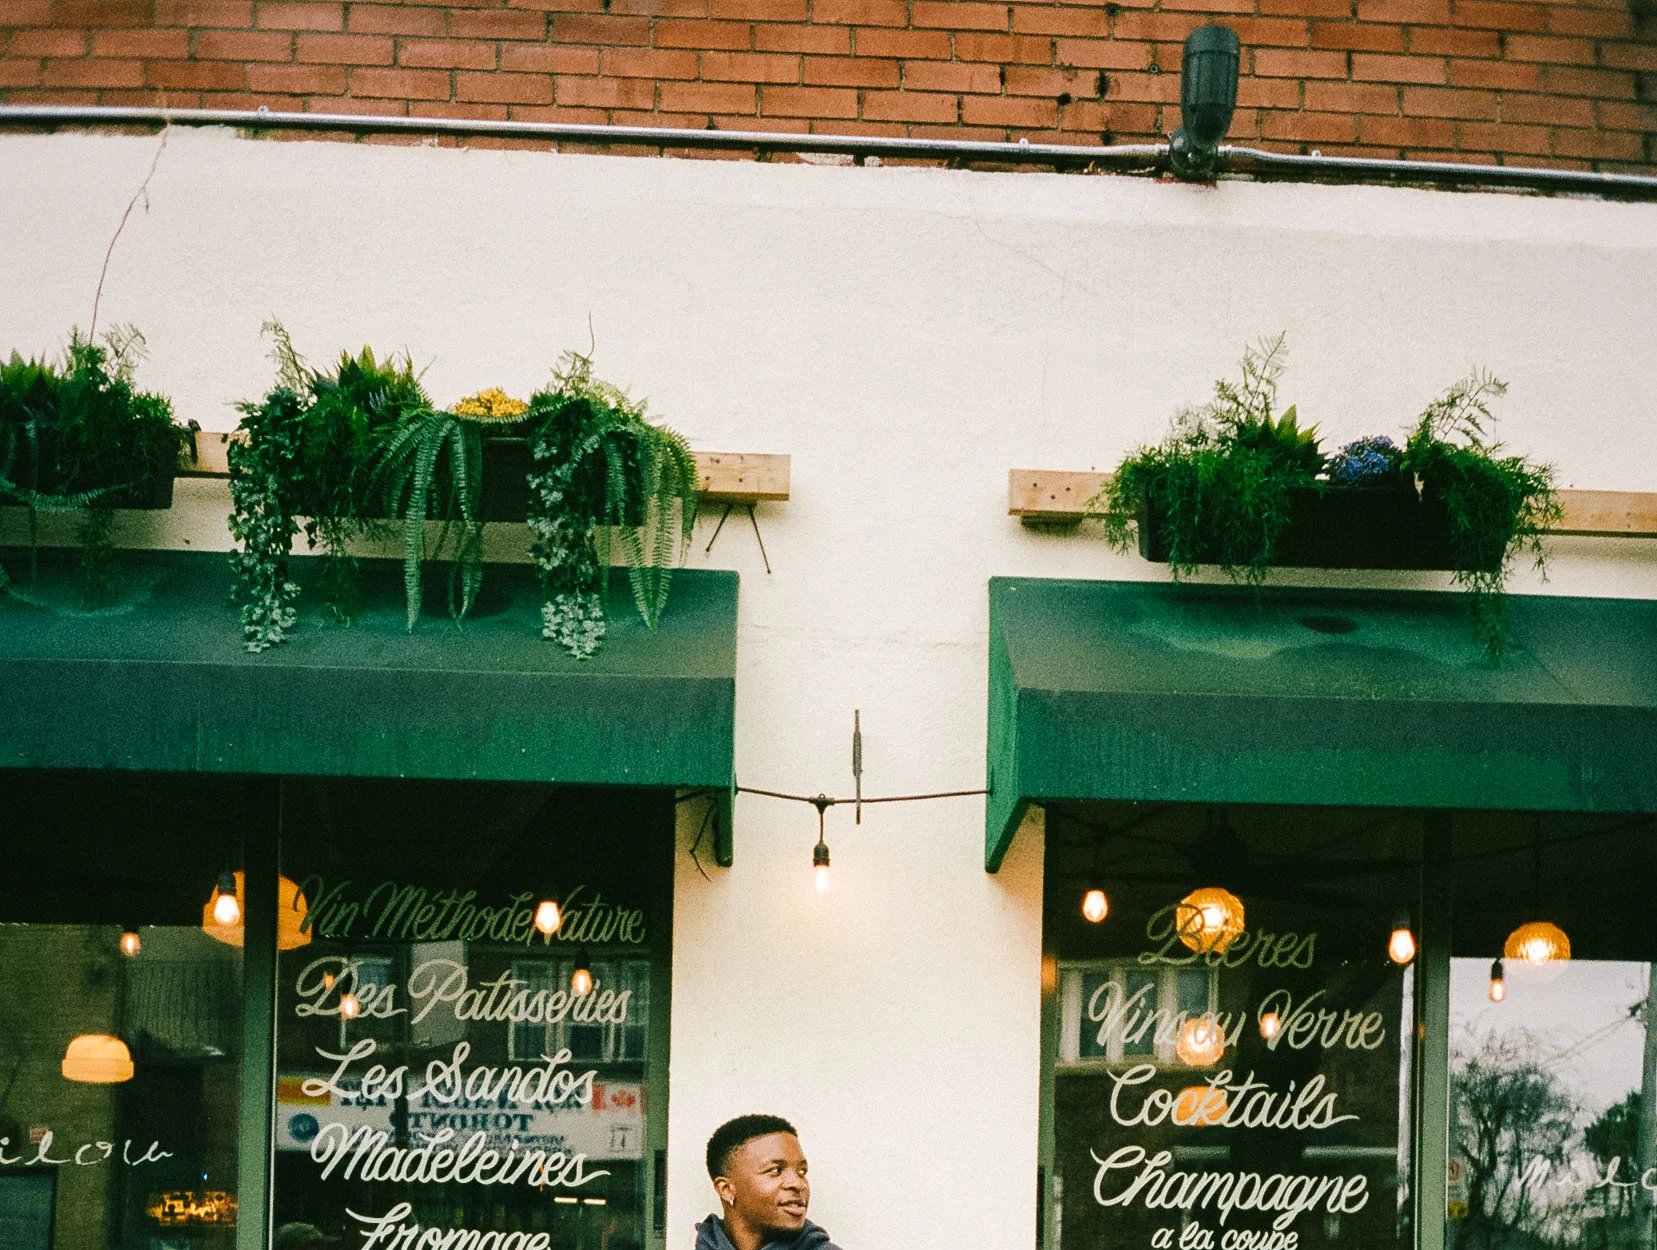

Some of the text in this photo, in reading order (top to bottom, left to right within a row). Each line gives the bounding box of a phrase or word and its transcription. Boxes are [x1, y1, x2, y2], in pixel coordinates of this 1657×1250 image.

[293, 874, 360, 936] Vin
[295, 955, 633, 1025] Des Patisseries
[1088, 980, 1386, 1052] Vins au Verre
[301, 1038, 409, 1101] Les
[406, 1041, 599, 1104] Sandos
[1106, 1063, 1360, 1131] Cocktails
[310, 1122, 611, 1188] Madeleines
[1089, 1145, 1370, 1231] Champagne
[1150, 1226, 1173, 1250] a
